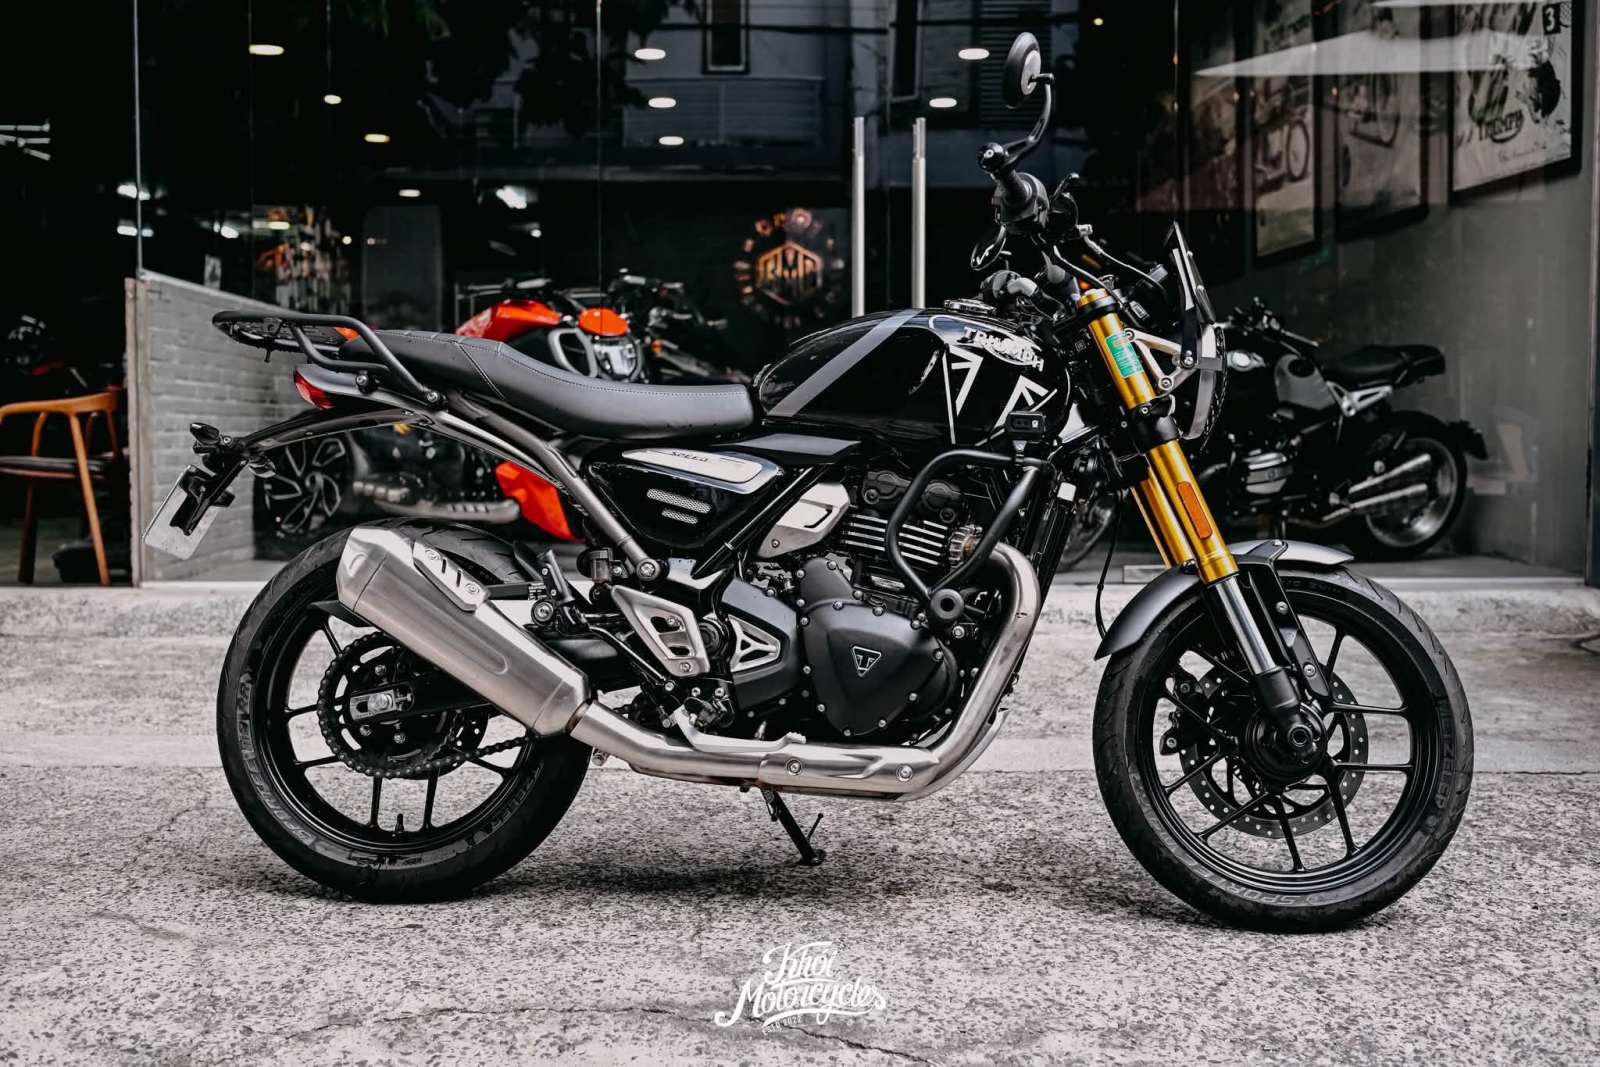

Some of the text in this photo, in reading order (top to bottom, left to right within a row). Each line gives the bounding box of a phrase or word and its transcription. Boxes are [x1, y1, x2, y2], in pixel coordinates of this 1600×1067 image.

[1545, 7, 1556, 32] 3
[964, 326, 1044, 372] TRIUMPH
[671, 451, 709, 463] SPEED
